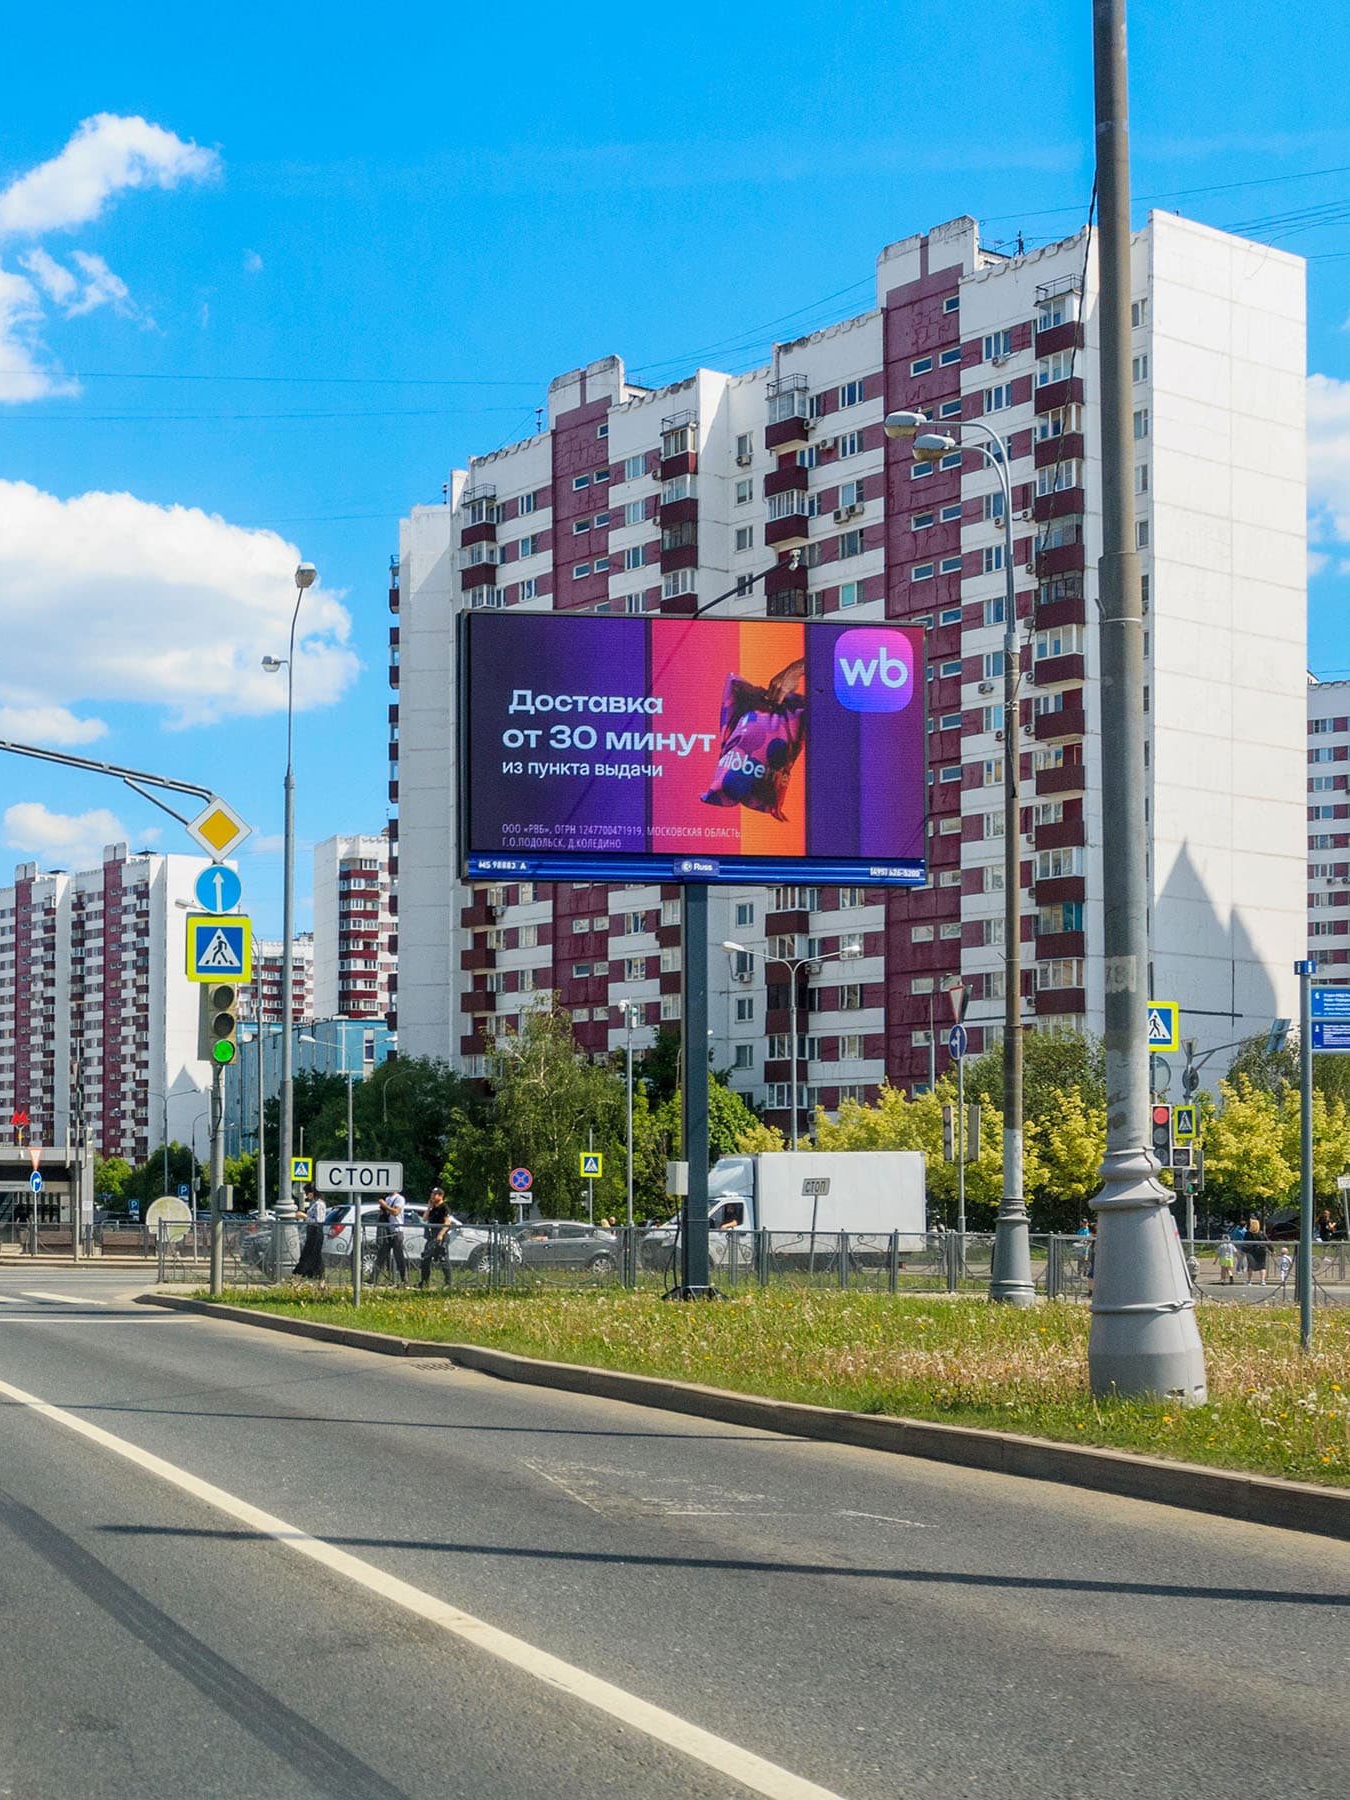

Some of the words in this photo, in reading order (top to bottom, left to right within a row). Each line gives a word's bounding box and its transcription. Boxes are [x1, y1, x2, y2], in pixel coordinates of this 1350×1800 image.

[839, 646, 909, 689] wb
[508, 689, 663, 715] Доставка
[502, 728, 543, 748] от
[549, 724, 598, 750] 30
[606, 731, 716, 757] минут
[502, 761, 524, 775] из
[528, 762, 590, 779] пункта
[595, 763, 663, 779] выдачи
[501, 823, 522, 835] ООО
[554, 824, 577, 836] ОГРН
[647, 826, 702, 837] МОСКОВСКАЯ
[693, 862, 714, 871] Russ
[328, 1167, 390, 1187] СТОП
[805, 1181, 826, 1193] СТОП
